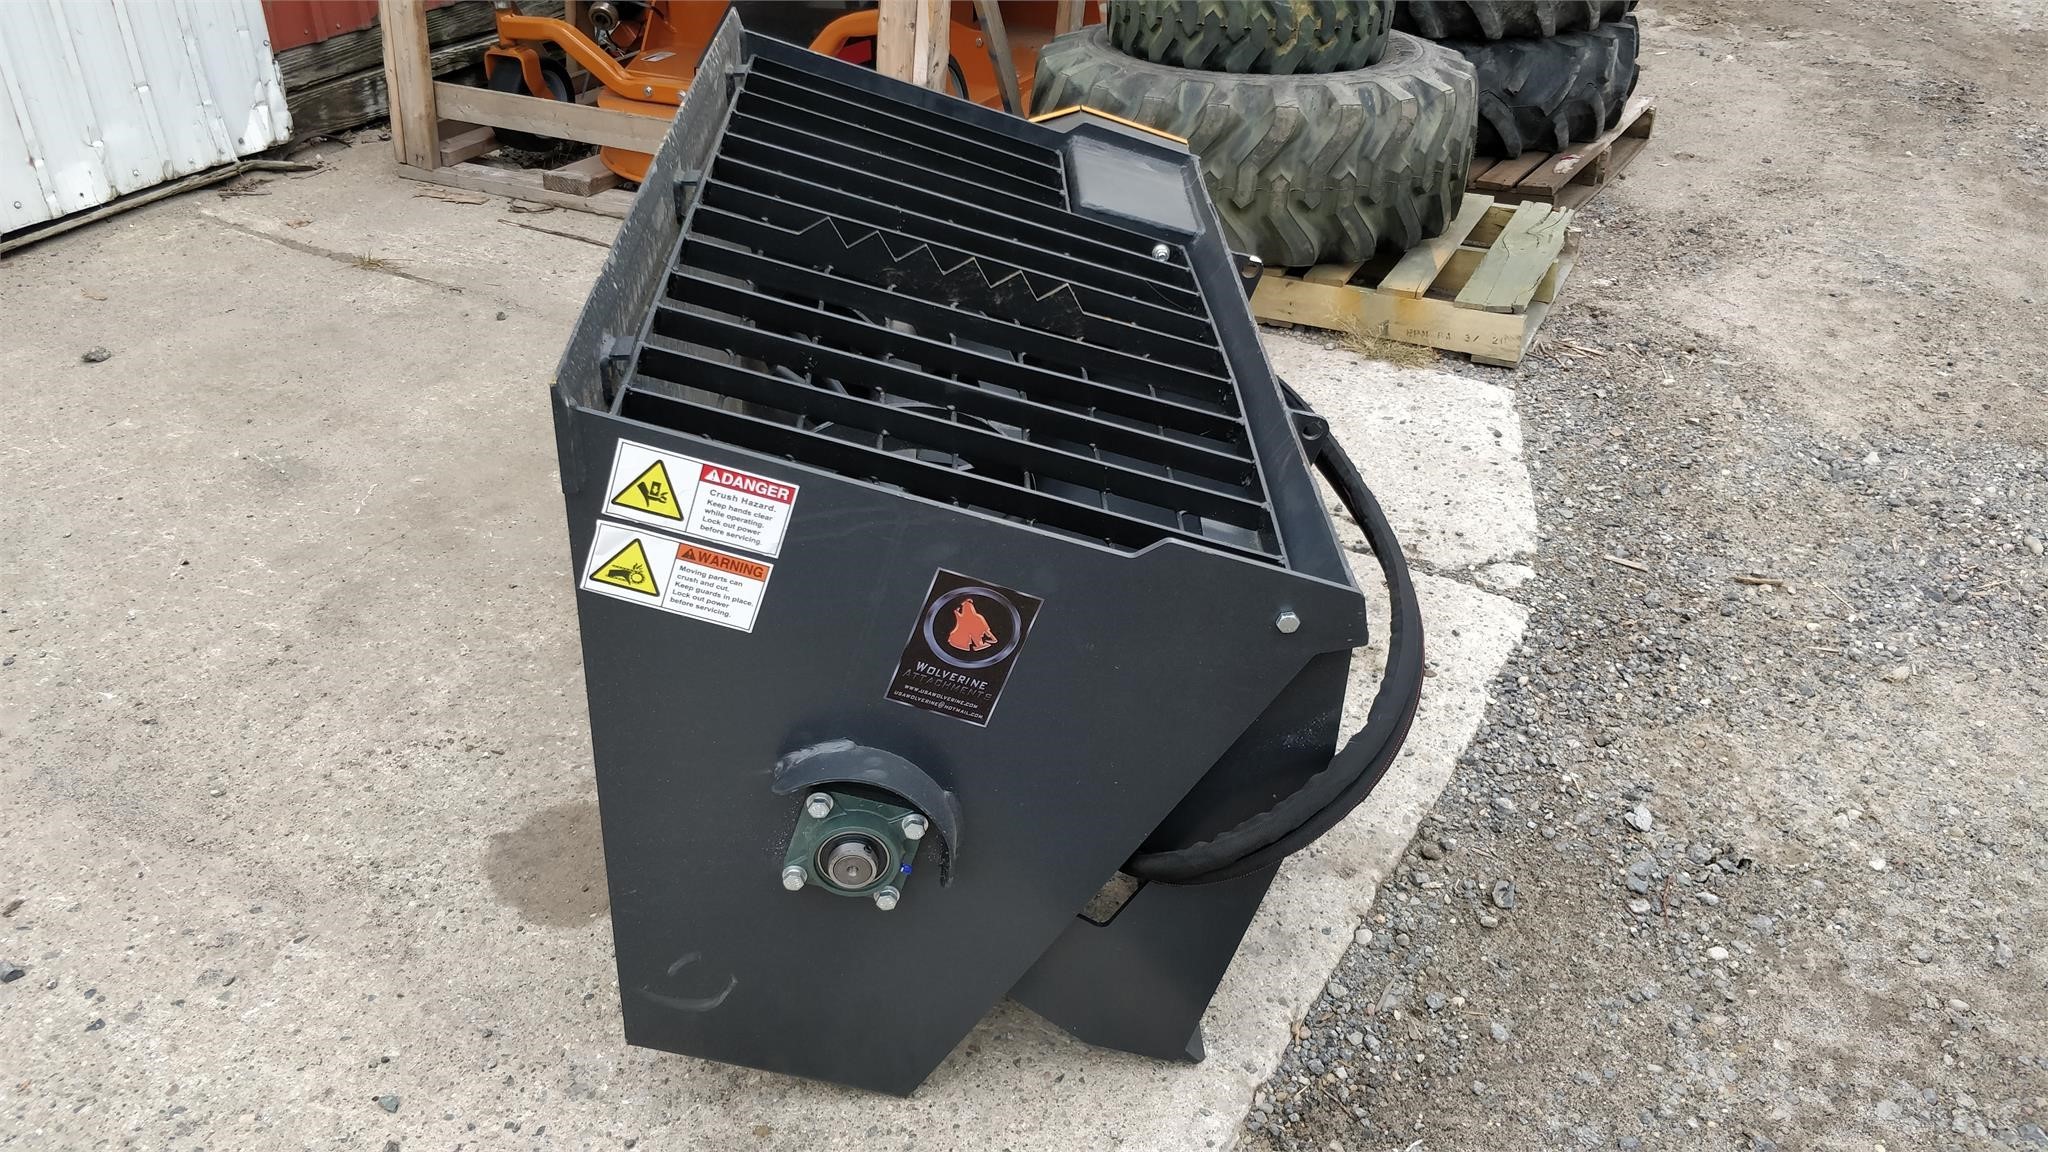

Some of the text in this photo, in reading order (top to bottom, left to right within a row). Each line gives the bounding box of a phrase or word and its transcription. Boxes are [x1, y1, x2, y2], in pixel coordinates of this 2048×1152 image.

[721, 472, 790, 500] DANGER
[706, 499, 773, 521] Keep hands clear
[709, 489, 777, 512] Crush Hazard.
[702, 516, 761, 536] Lock out power
[704, 508, 765, 529] while operating.
[700, 524, 725, 536] before
[698, 550, 764, 578] WARNING
[676, 574, 730, 592] crush and cut.
[679, 565, 743, 587] Moving parts can
[672, 589, 730, 609] Lock out power
[674, 581, 694, 592] Keep
[695, 587, 722, 598] guards
[731, 596, 754, 607] place.
[669, 597, 732, 618] before servicing.
[902, 668, 993, 701] ATTACHMENTS
[916, 661, 989, 690] WOLVERINE
